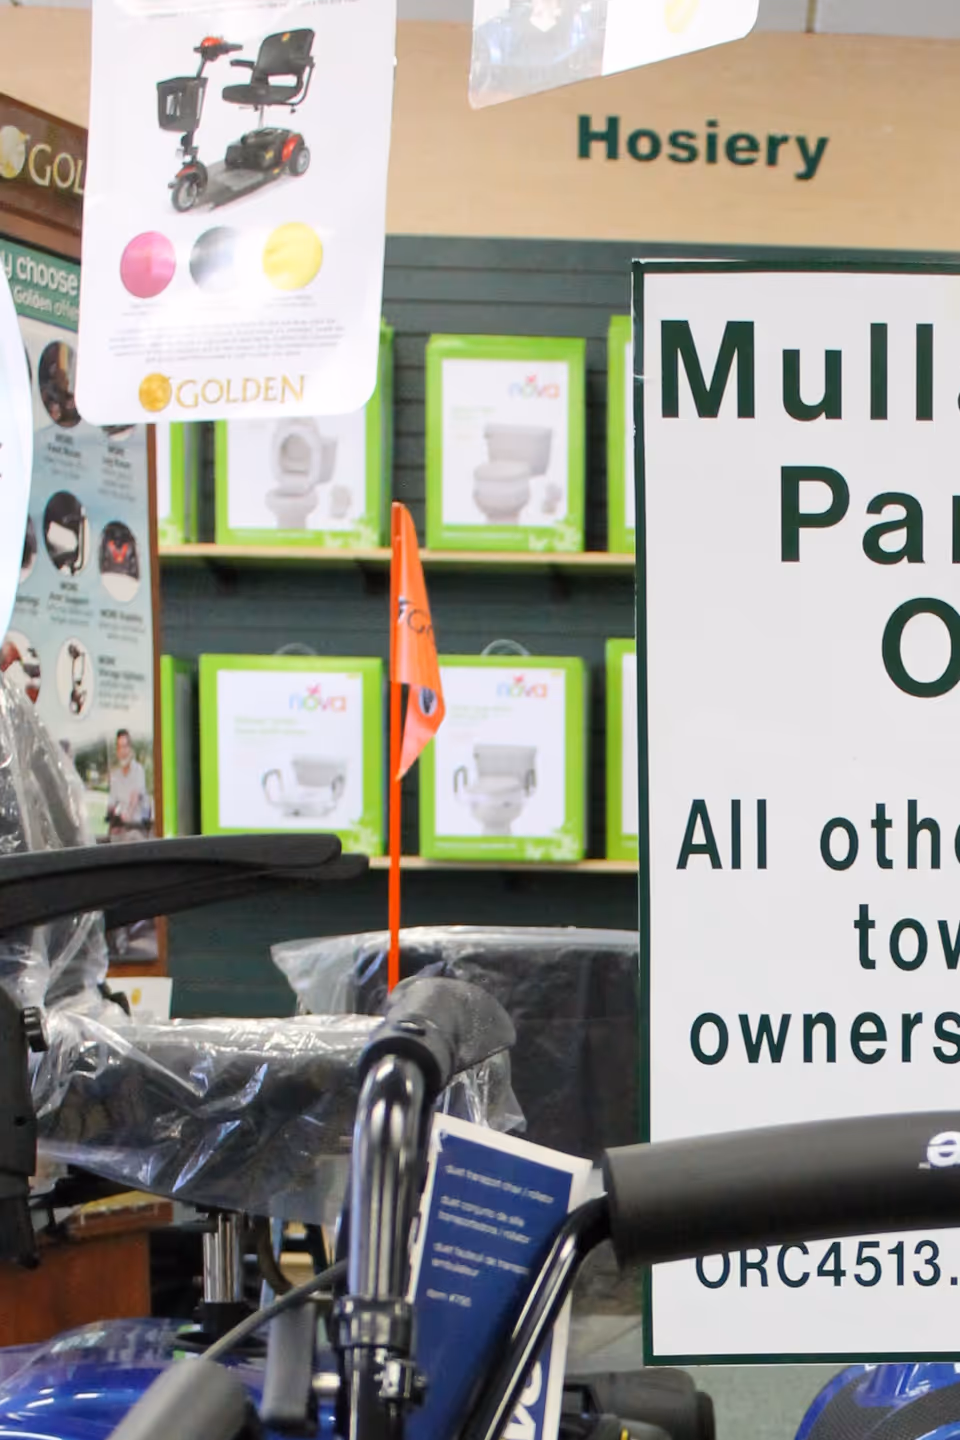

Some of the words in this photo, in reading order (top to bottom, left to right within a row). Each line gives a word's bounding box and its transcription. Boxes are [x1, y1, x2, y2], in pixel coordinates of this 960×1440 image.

[578, 114, 829, 181] Hosiery
[16, 256, 79, 297] choose
[175, 373, 306, 409] GOLDEN
[289, 690, 346, 713] nova
[676, 798, 767, 870] All
